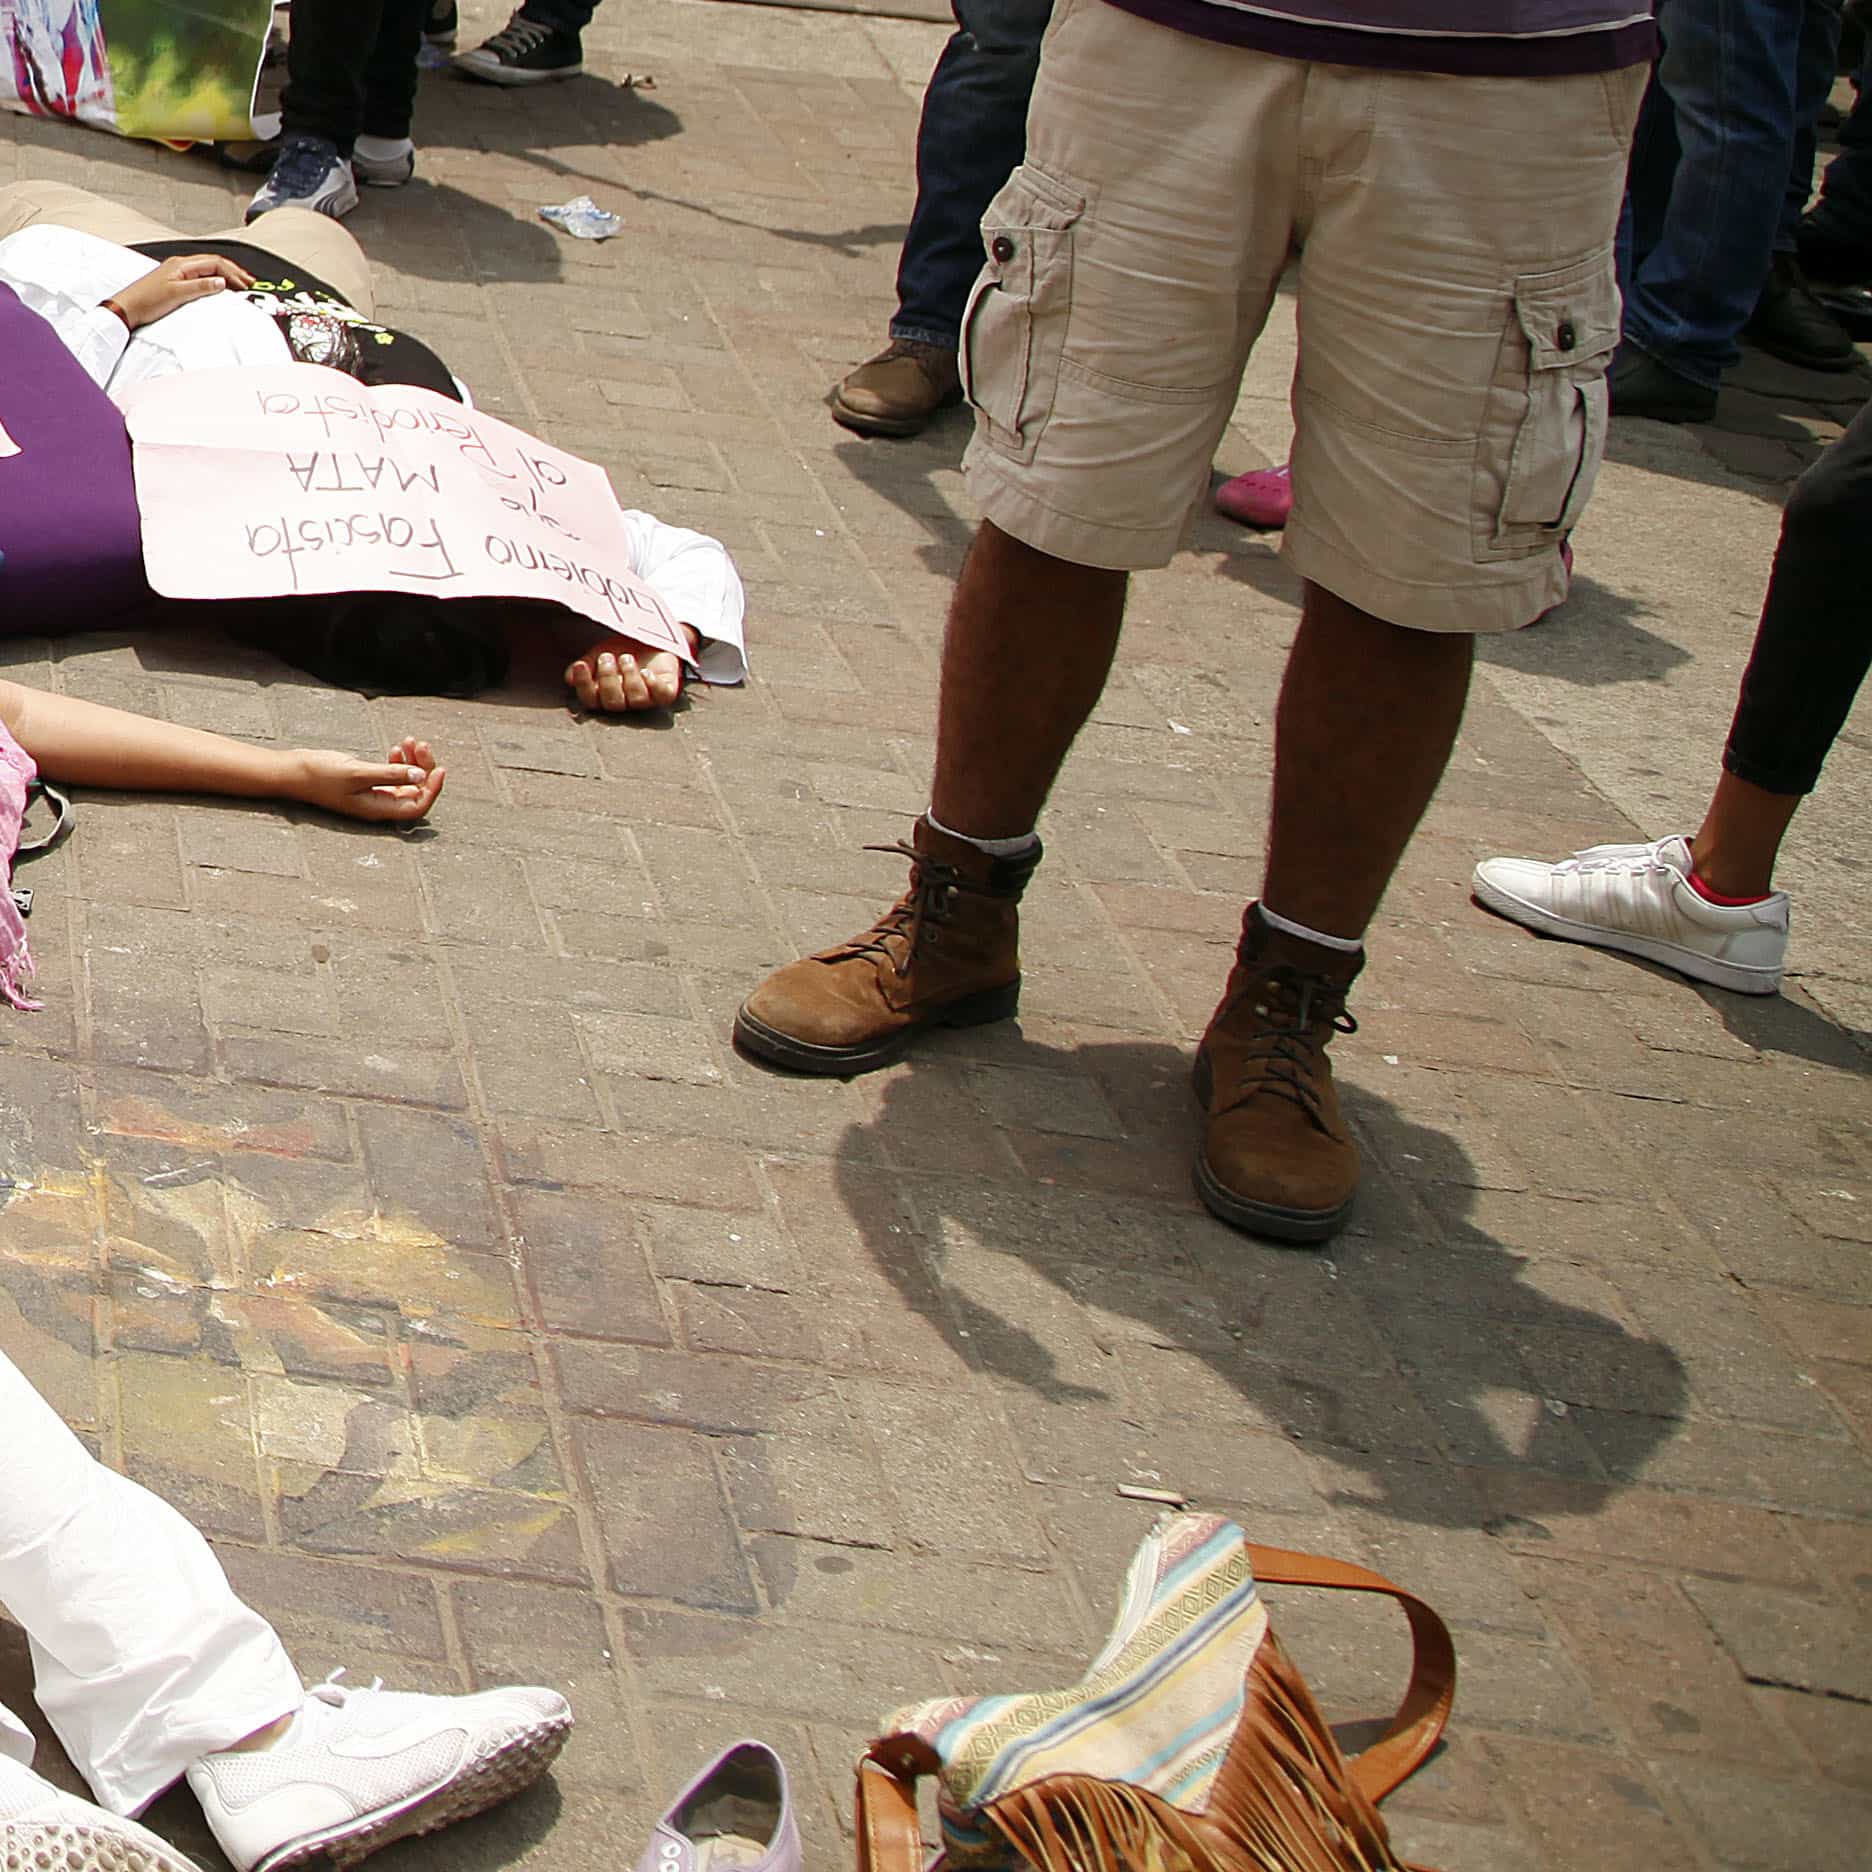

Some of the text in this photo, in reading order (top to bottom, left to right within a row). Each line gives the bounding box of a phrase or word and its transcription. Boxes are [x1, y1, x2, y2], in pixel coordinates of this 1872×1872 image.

[256, 390, 518, 481] Periodista
[285, 451, 441, 493] MATA
[244, 512, 464, 590] Fascista
[484, 535, 680, 645] Gobierno
